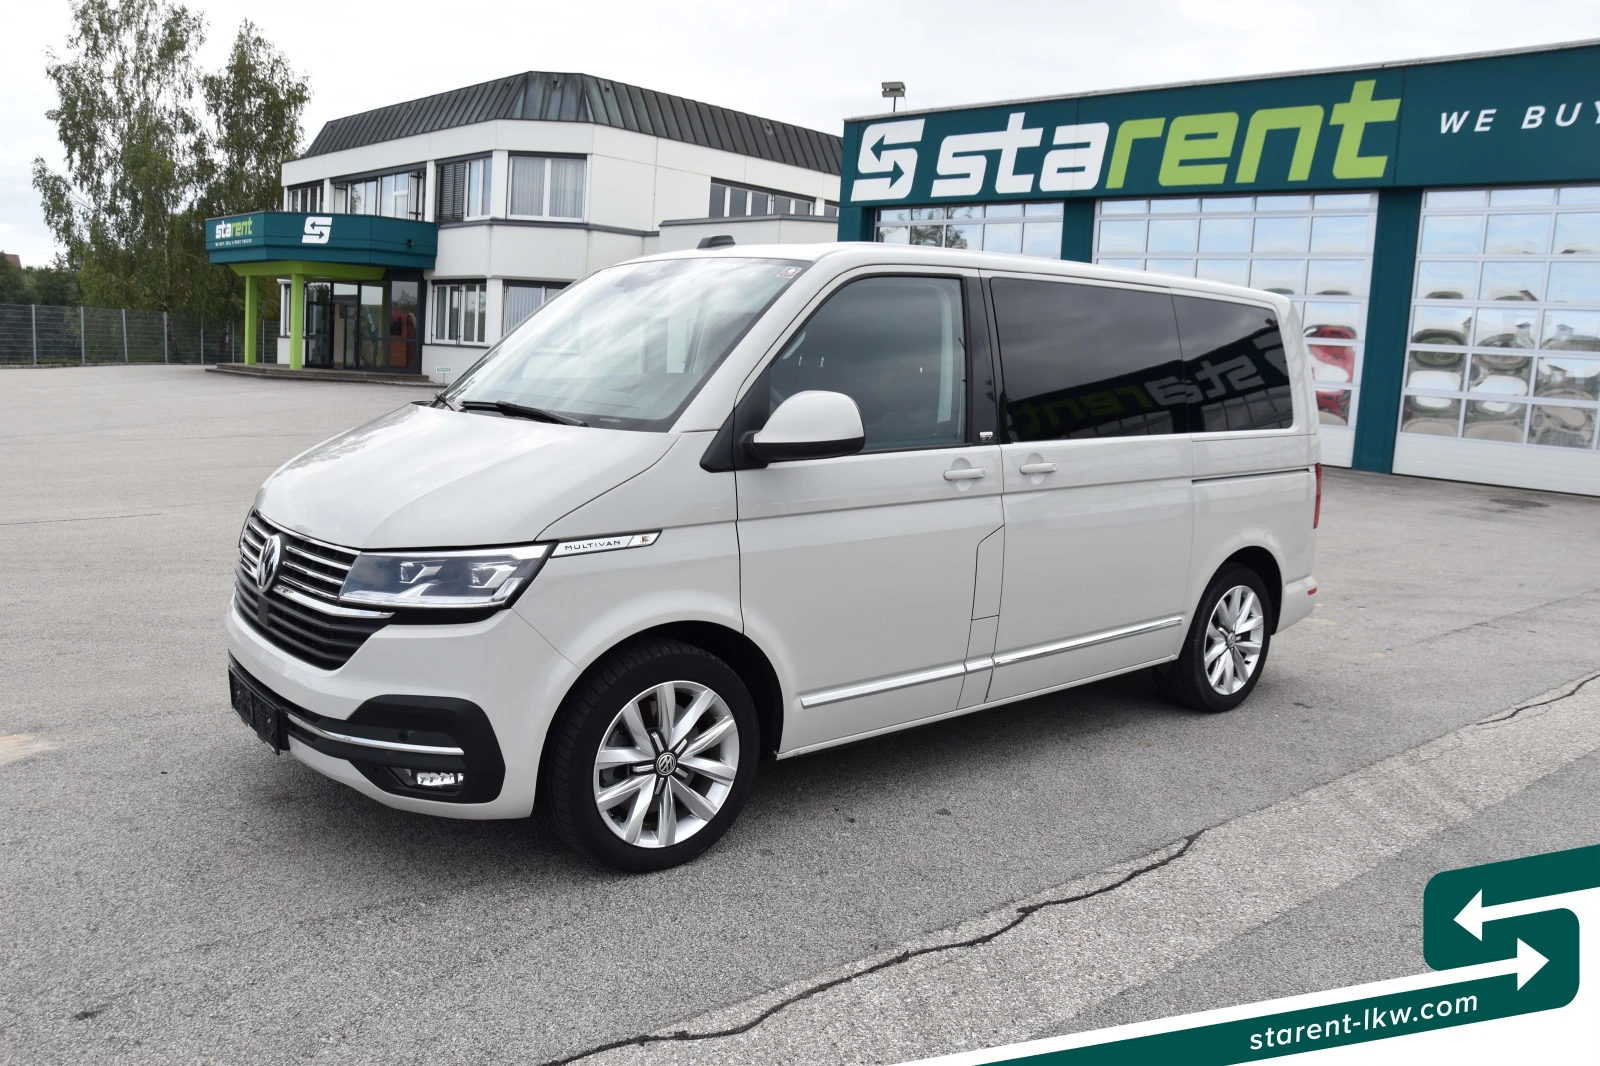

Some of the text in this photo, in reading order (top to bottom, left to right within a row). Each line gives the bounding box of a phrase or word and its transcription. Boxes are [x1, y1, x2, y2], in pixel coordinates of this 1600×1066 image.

[1440, 100, 1600, 134] WE BU
[931, 80, 1402, 198] starent
[215, 216, 253, 239] starent
[564, 540, 621, 551] MULTIVAN
